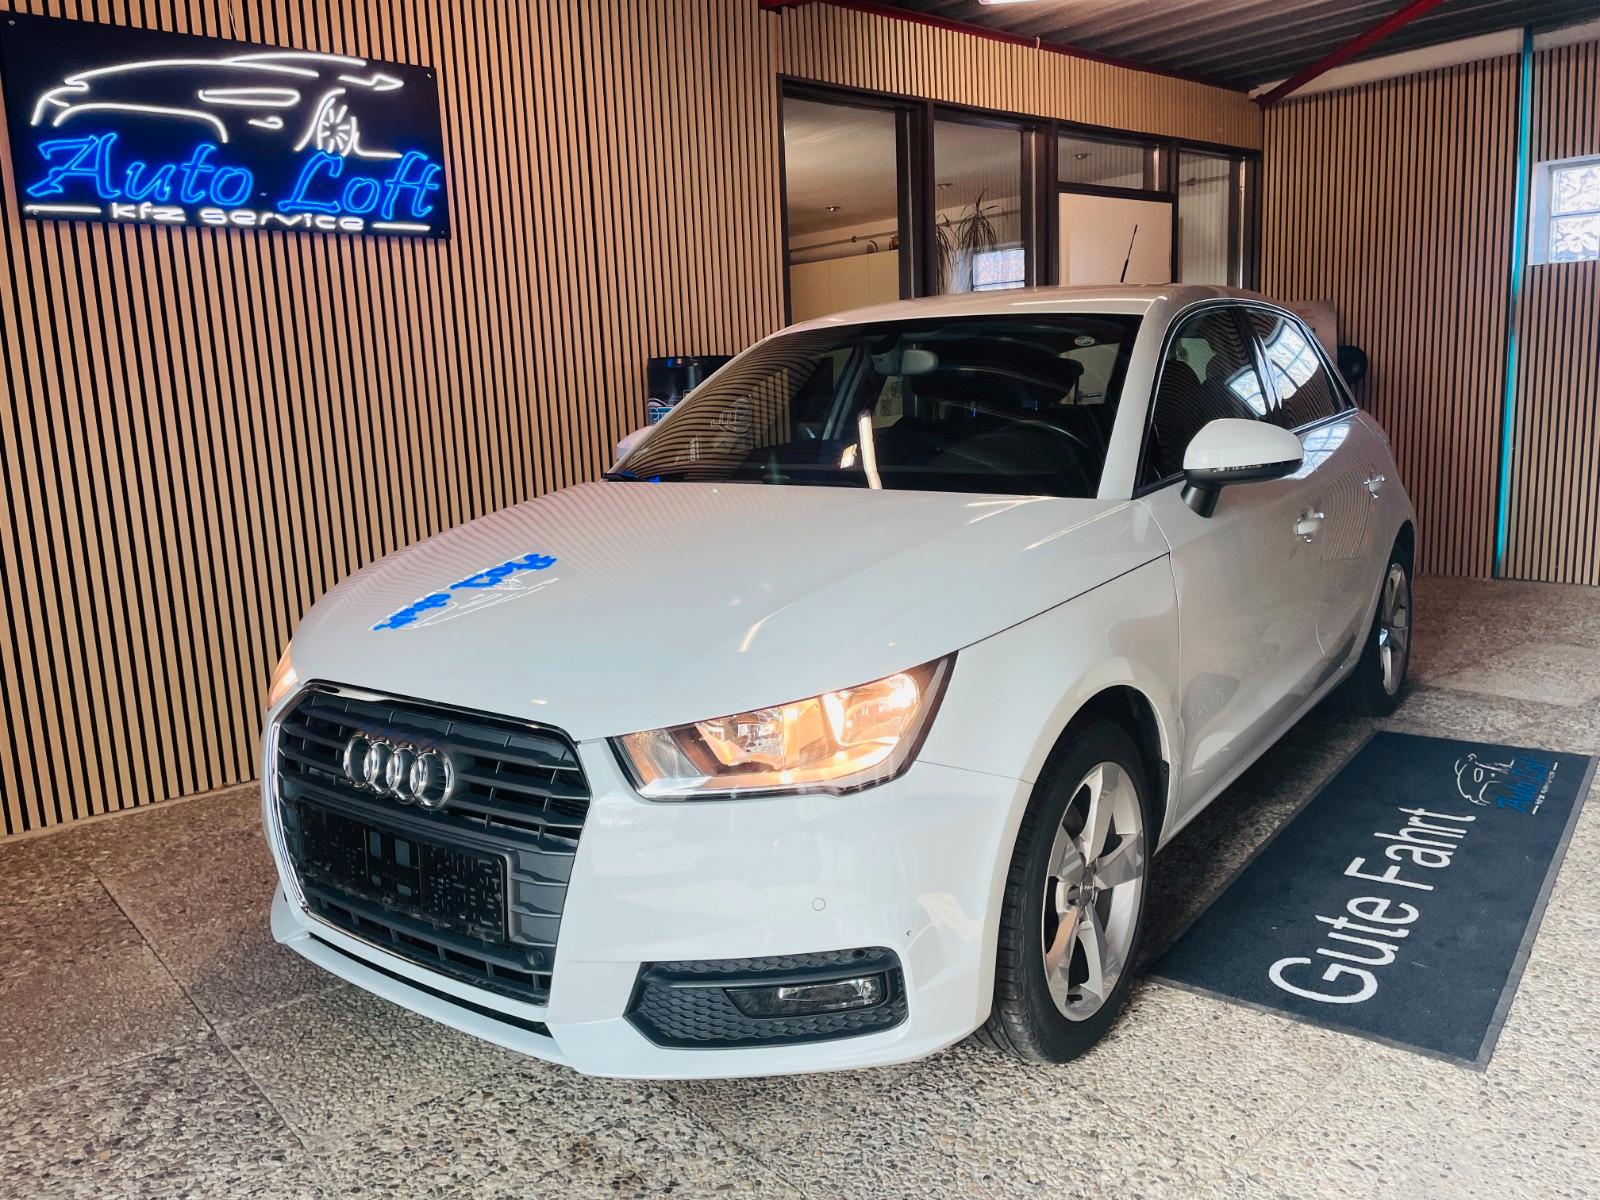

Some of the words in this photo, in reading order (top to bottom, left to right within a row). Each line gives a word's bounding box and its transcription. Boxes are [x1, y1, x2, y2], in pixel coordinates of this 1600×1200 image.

[26, 132, 253, 206] Auto
[277, 150, 442, 220] Loft
[200, 208, 365, 230] service
[1268, 896, 1420, 1004] Gute
[1344, 806, 1476, 891] Fahrt
